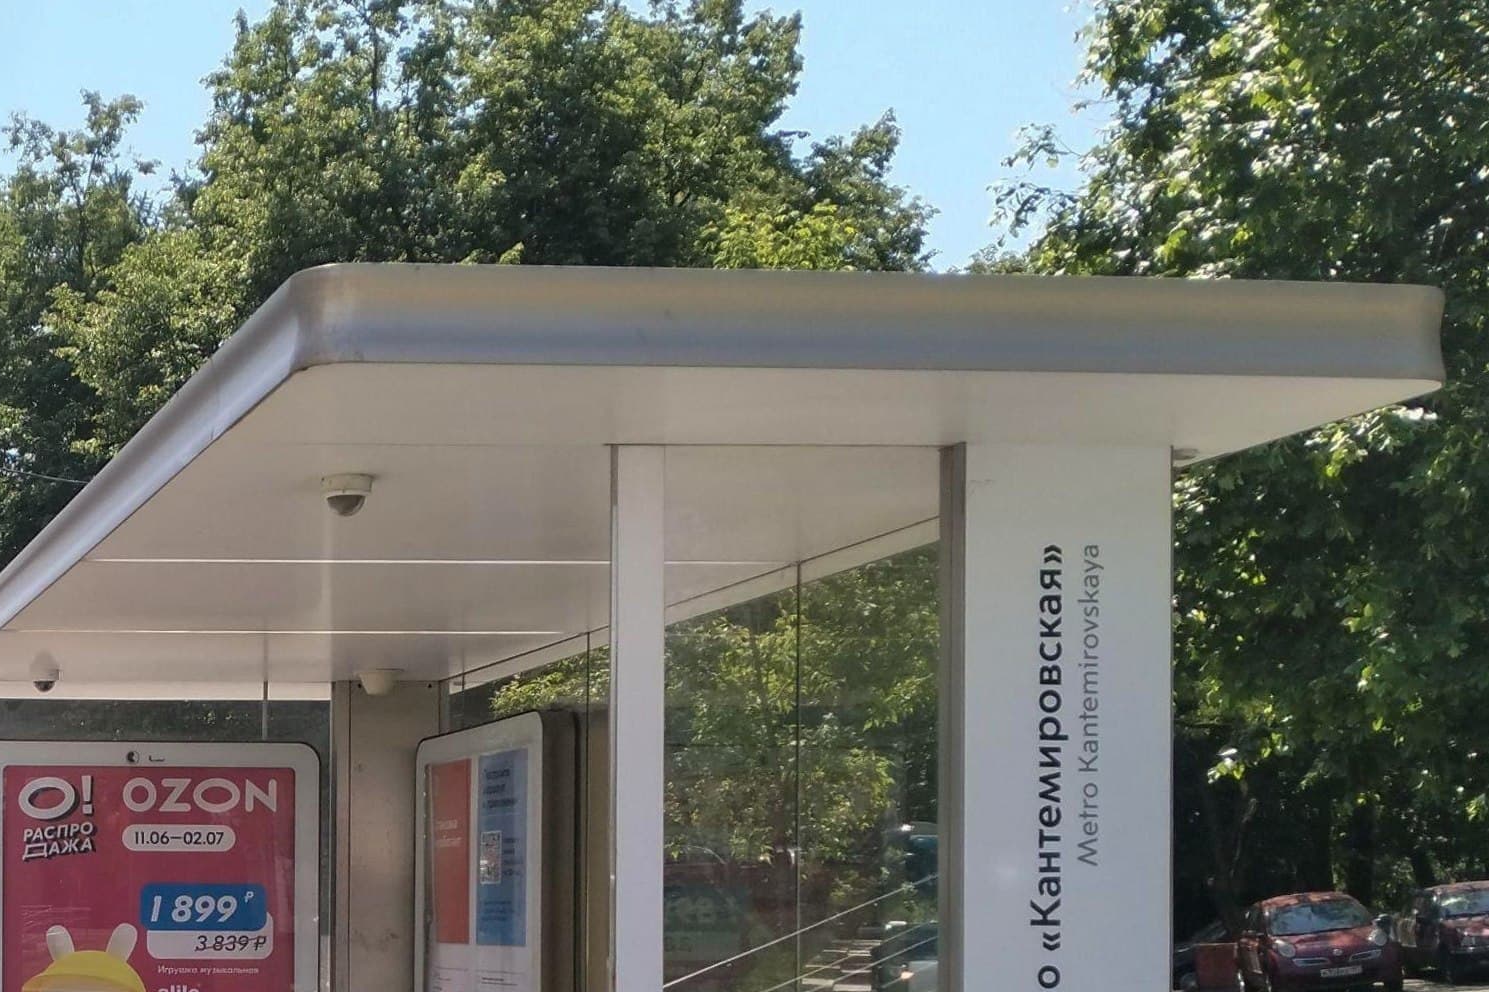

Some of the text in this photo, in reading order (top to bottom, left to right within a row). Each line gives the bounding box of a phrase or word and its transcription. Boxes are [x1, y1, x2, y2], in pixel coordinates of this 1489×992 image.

[1076, 544, 1104, 866] Metro Kantemirovskaya
[1029, 544, 1069, 951] «Кантемировская»
[122, 776, 278, 814] OZON
[23, 821, 94, 842] РАСПРО
[22, 837, 93, 860] ДАЖА
[171, 895, 238, 922] 899
[212, 935, 249, 951] 839
